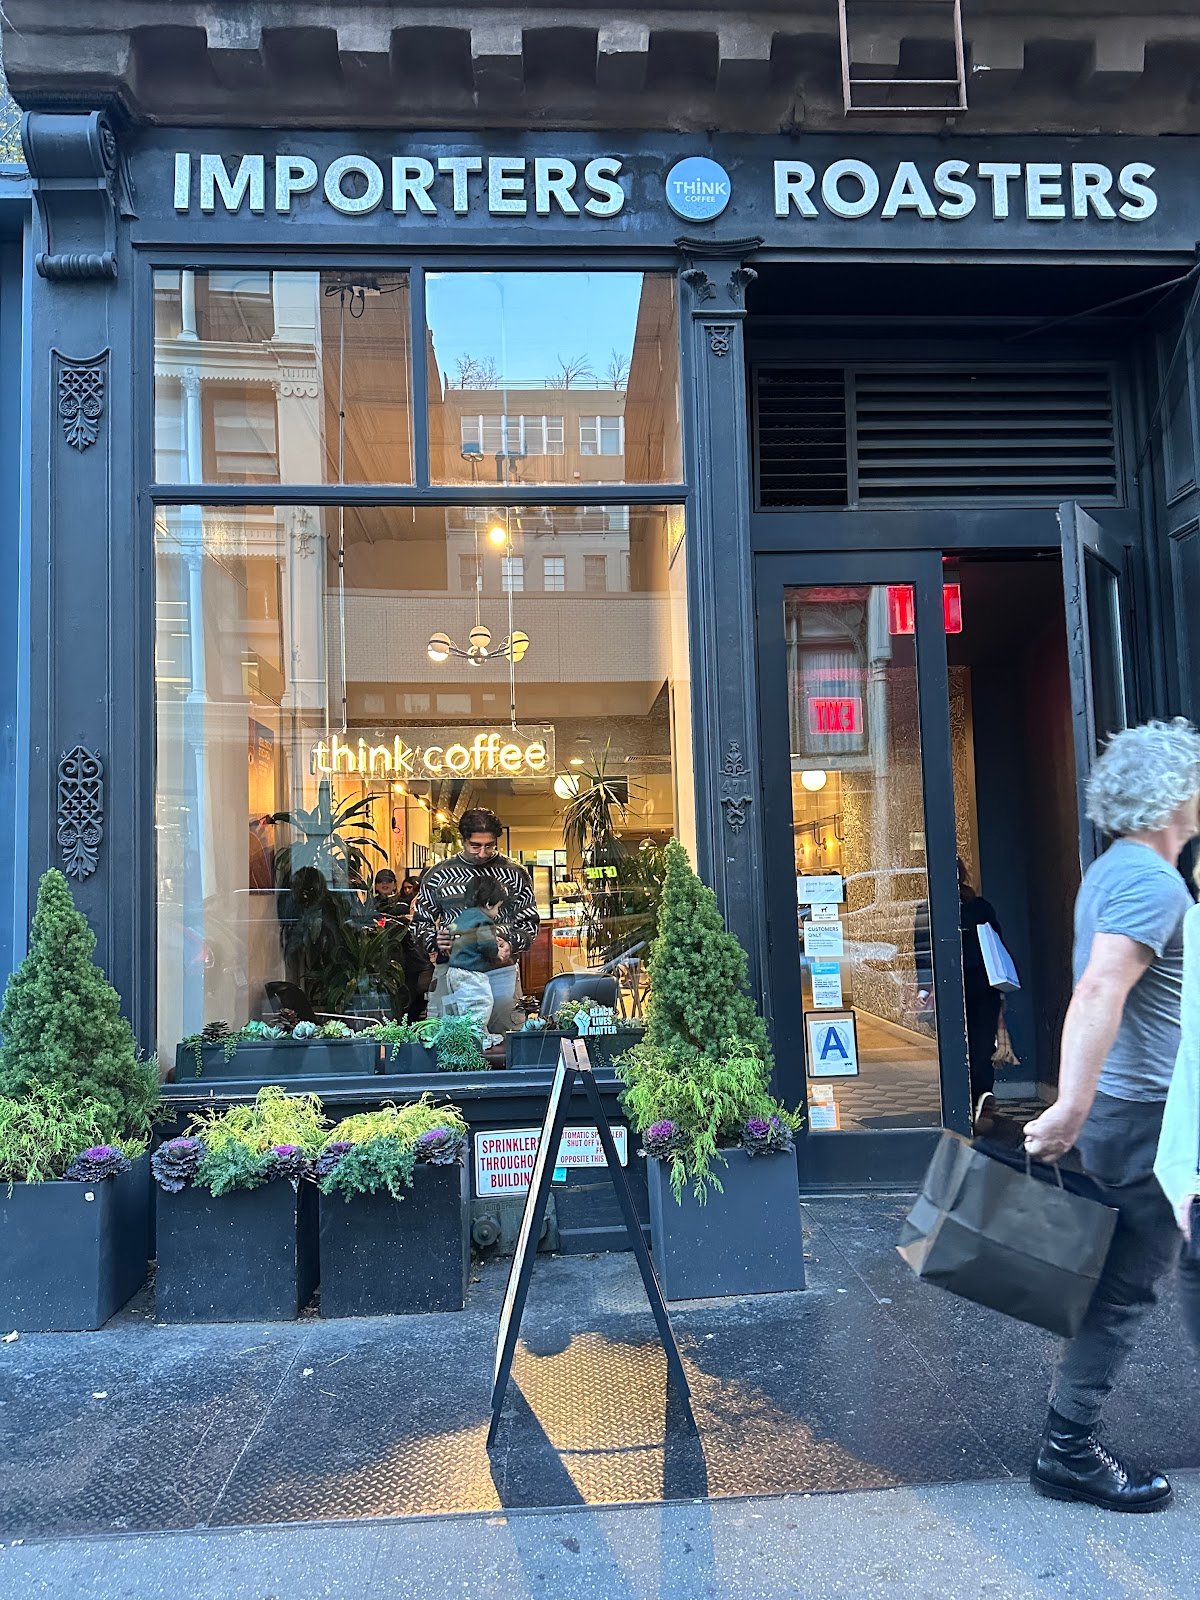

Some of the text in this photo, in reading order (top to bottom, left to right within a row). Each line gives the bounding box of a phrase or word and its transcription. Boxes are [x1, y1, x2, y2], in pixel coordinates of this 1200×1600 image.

[173, 152, 625, 218] IMPORTERS
[773, 158, 1158, 221] ROASTERS
[684, 195, 716, 203] COFFEE
[312, 733, 414, 773] think
[422, 732, 547, 772] coffee
[589, 1006, 615, 1017] BLACK
[592, 1016, 612, 1026] LIVES
[588, 1025, 618, 1036] MATTER
[820, 1026, 849, 1060] A
[567, 1139, 582, 1147] SHUT
[583, 1139, 595, 1147] OFF
[480, 1154, 536, 1171] THROUGHO
[560, 1154, 605, 1163] OPPOSITE THIS
[490, 1171, 530, 1188] BUILDIN
